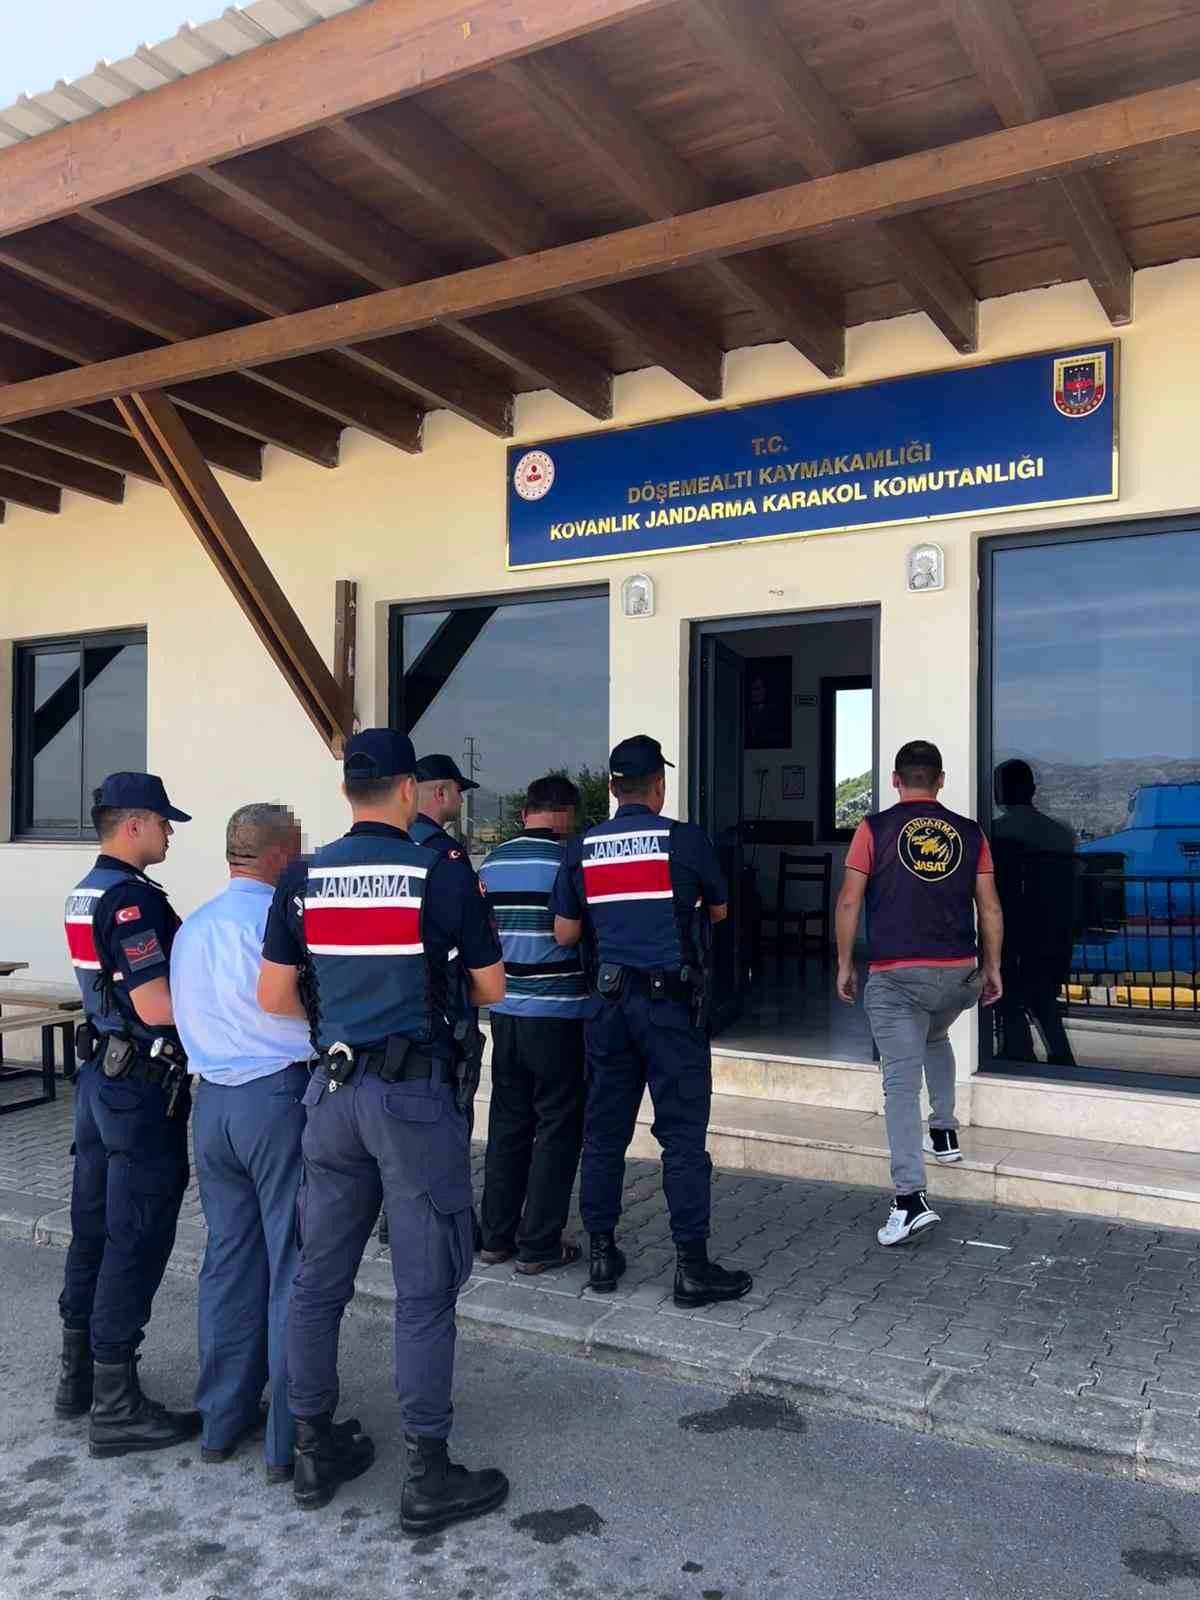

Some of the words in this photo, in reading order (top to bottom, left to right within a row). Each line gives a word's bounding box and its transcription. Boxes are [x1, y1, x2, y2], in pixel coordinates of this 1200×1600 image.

[752, 435, 789, 455] T.C.
[627, 469, 753, 504] DÖŞEMEALTI
[759, 440, 932, 486] KAYMAKAMLIĞI
[550, 513, 641, 541] KOVANLIK
[645, 500, 756, 529] JANDARMA
[762, 483, 867, 513] KARAKOL
[873, 455, 1044, 498] KOMUTANLIĞI
[590, 836, 661, 859] JANDARMA
[316, 874, 411, 898] JANDARMA
